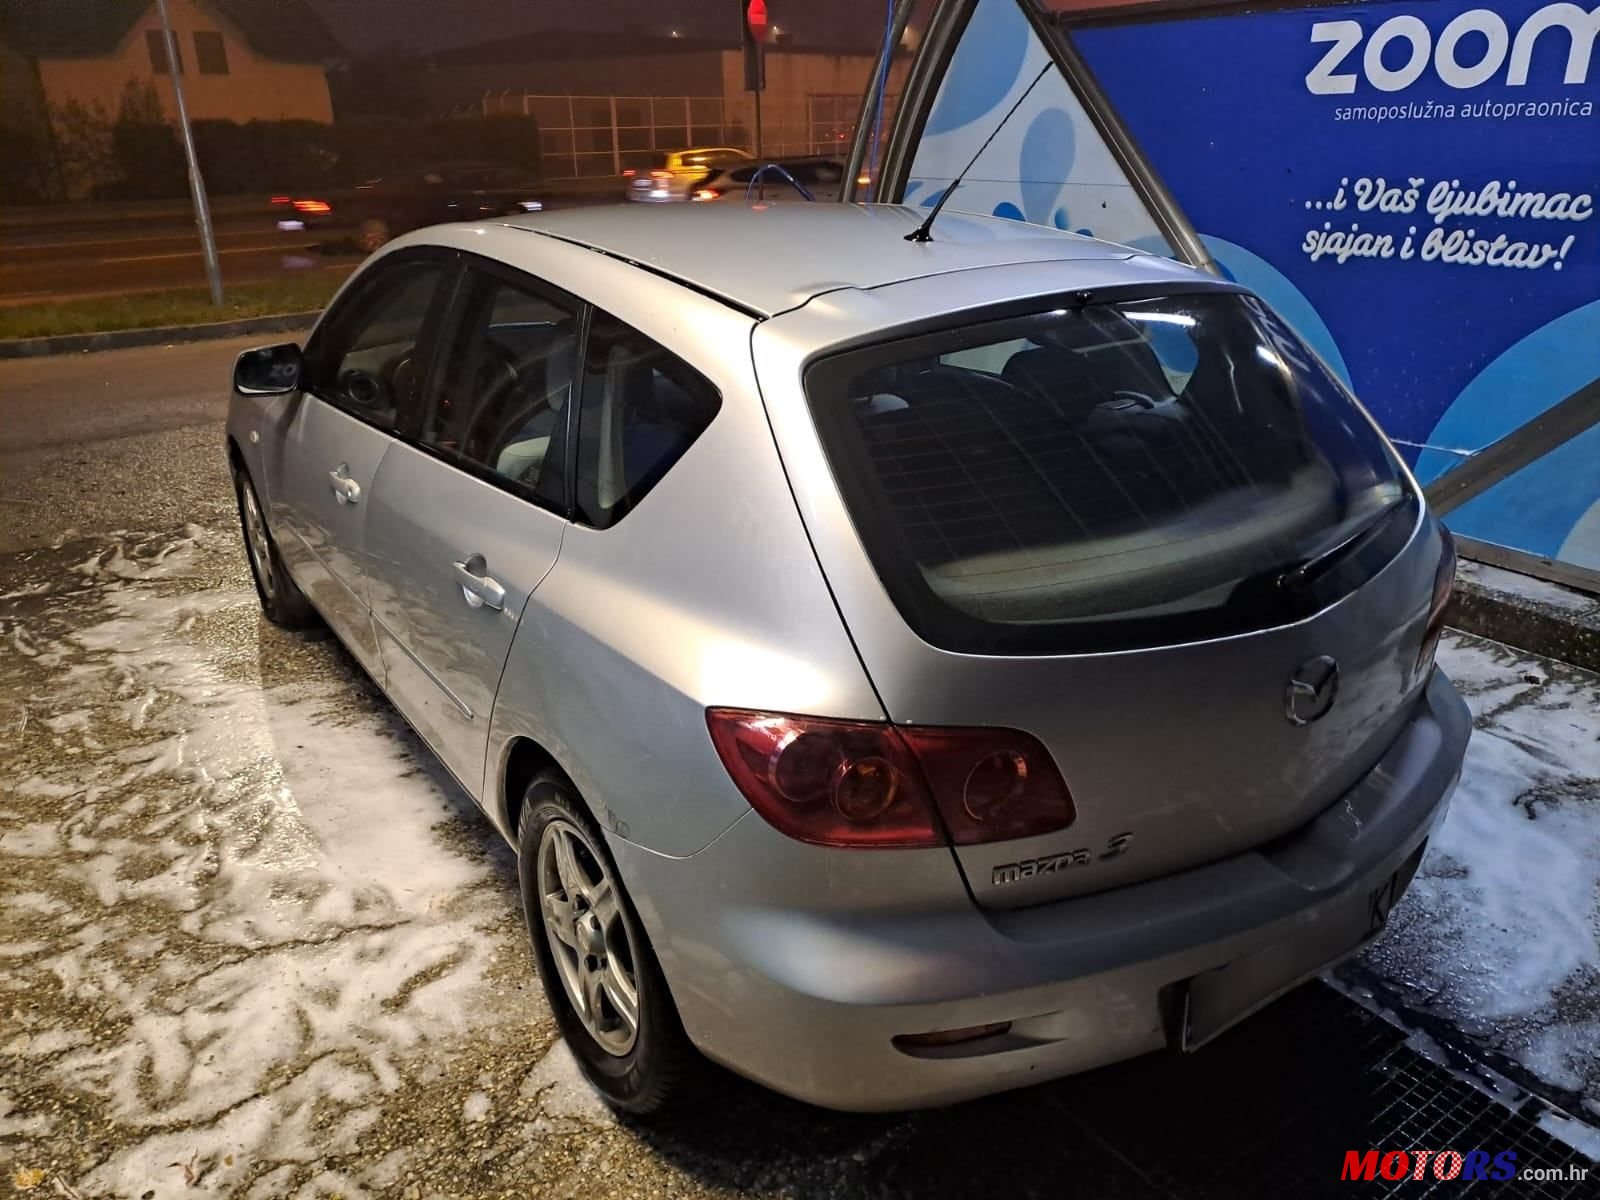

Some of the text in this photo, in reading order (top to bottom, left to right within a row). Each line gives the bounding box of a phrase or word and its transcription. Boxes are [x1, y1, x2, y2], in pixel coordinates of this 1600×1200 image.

[1305, 3, 1600, 95] zoom
[1334, 99, 1593, 122] samoposlužna autopraonica
[1354, 177, 1425, 213] Vaš
[1427, 180, 1593, 224] ljubimac
[1302, 222, 1575, 270] sjajan i blistav!
